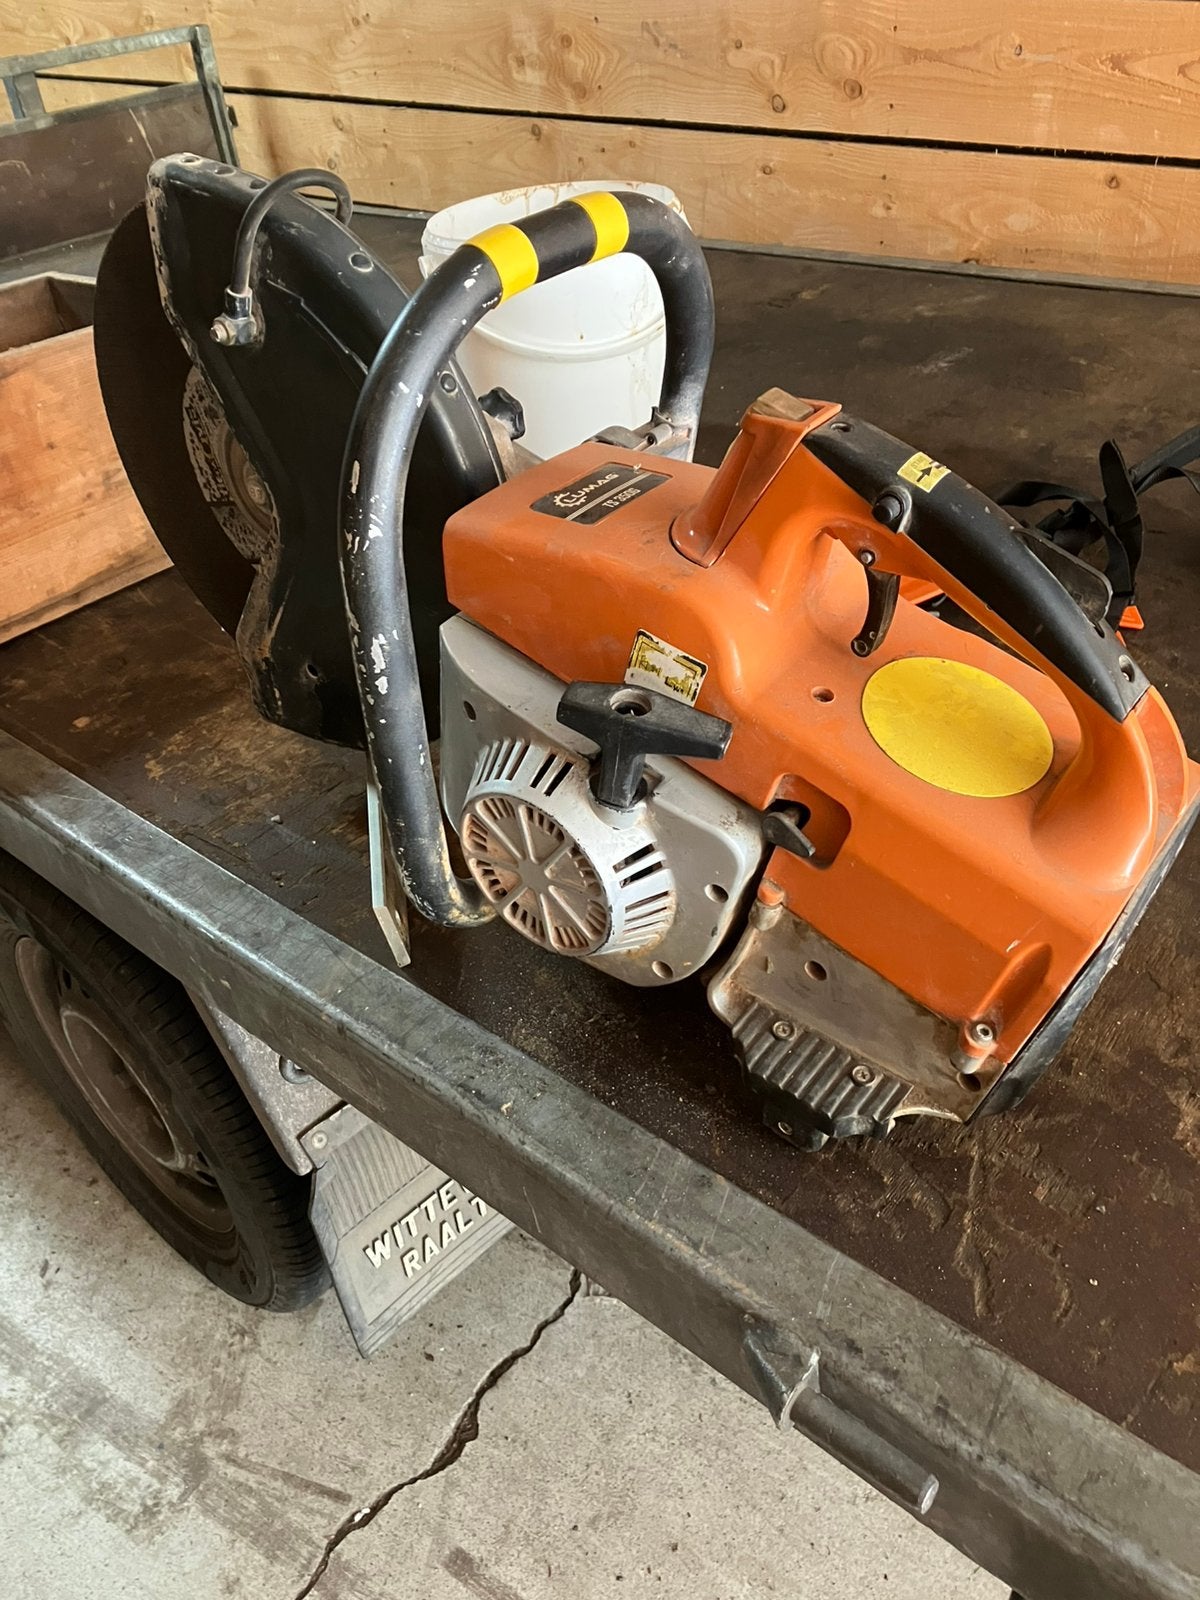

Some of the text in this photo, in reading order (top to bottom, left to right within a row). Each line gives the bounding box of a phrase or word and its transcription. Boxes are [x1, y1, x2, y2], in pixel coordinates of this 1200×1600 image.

[563, 473, 620, 503] LUMAG
[601, 499, 620, 508] TS
[363, 1179, 470, 1269] WITTE
